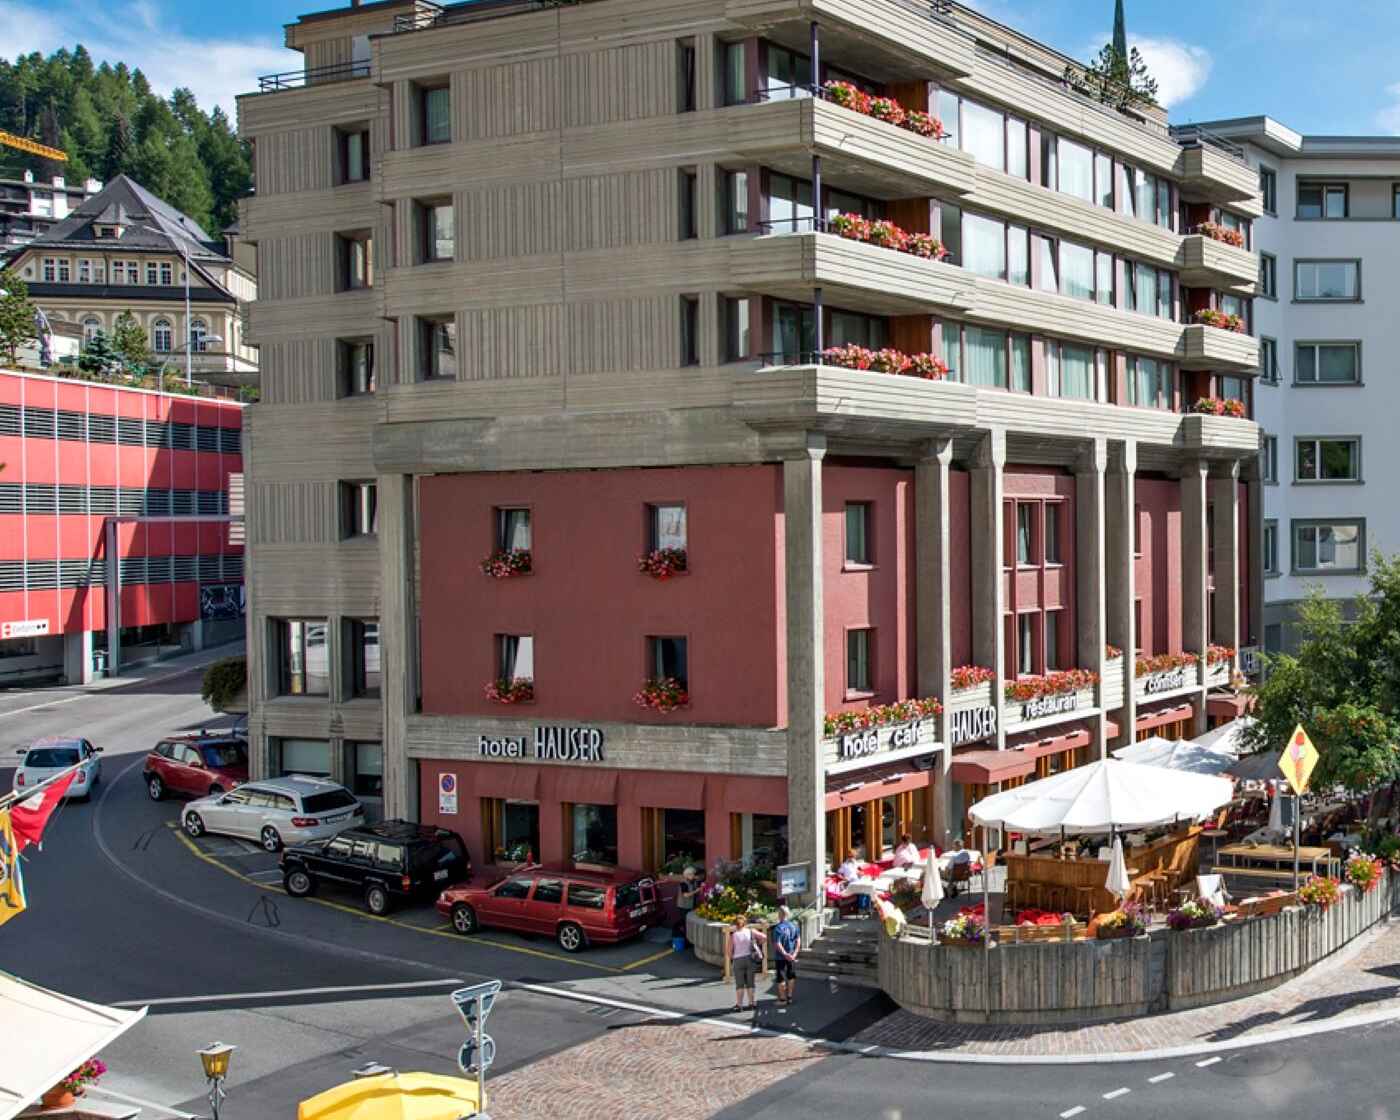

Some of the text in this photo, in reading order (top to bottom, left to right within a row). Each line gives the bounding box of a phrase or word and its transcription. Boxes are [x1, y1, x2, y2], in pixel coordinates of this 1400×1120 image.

[952, 705, 997, 743] HAUSER
[478, 727, 601, 761] hotel HAUSER
[843, 729, 880, 757] hotel
